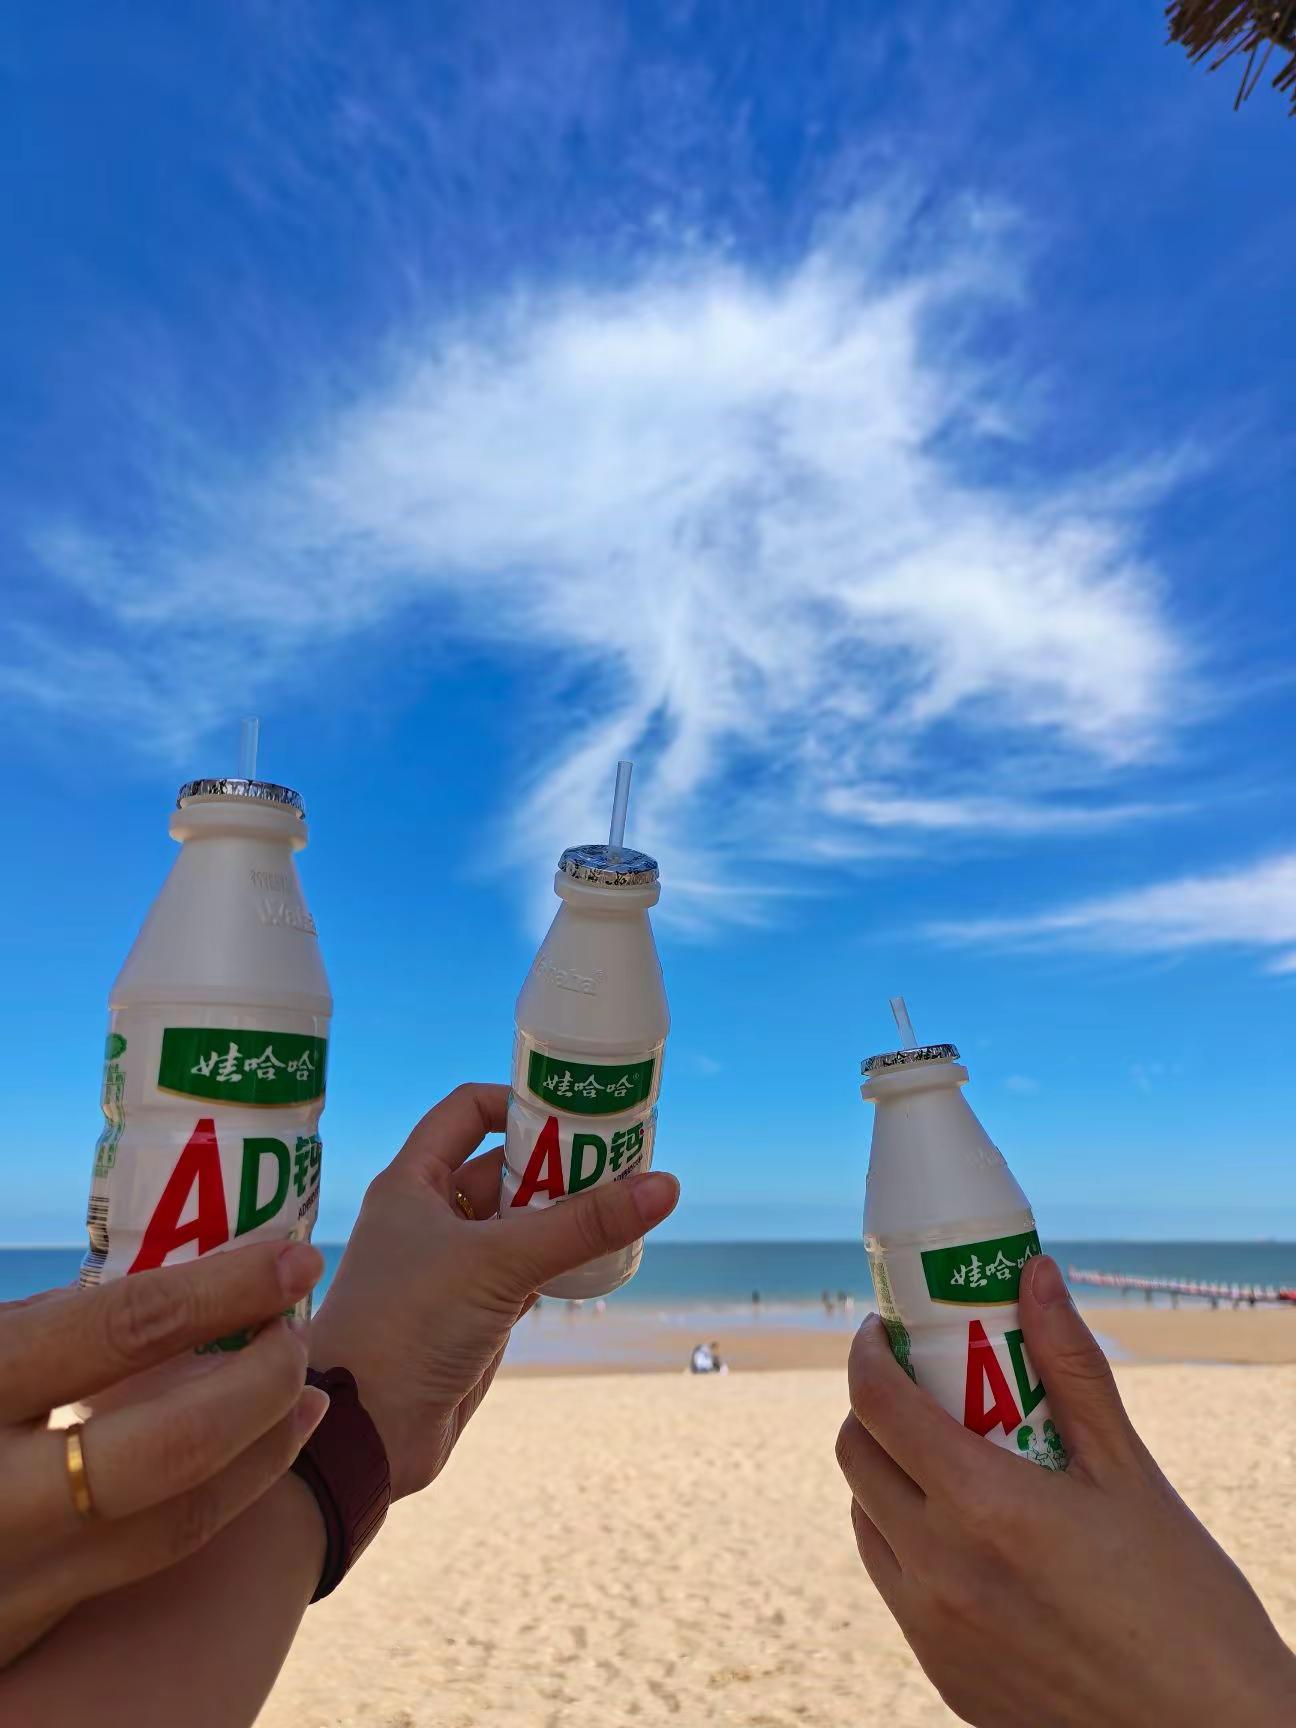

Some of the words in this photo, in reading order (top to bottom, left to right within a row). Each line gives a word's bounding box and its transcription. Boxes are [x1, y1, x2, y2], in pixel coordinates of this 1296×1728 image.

[190, 1041, 315, 1082] 娃哈哈
[542, 1070, 634, 1099] 娃哈哈
